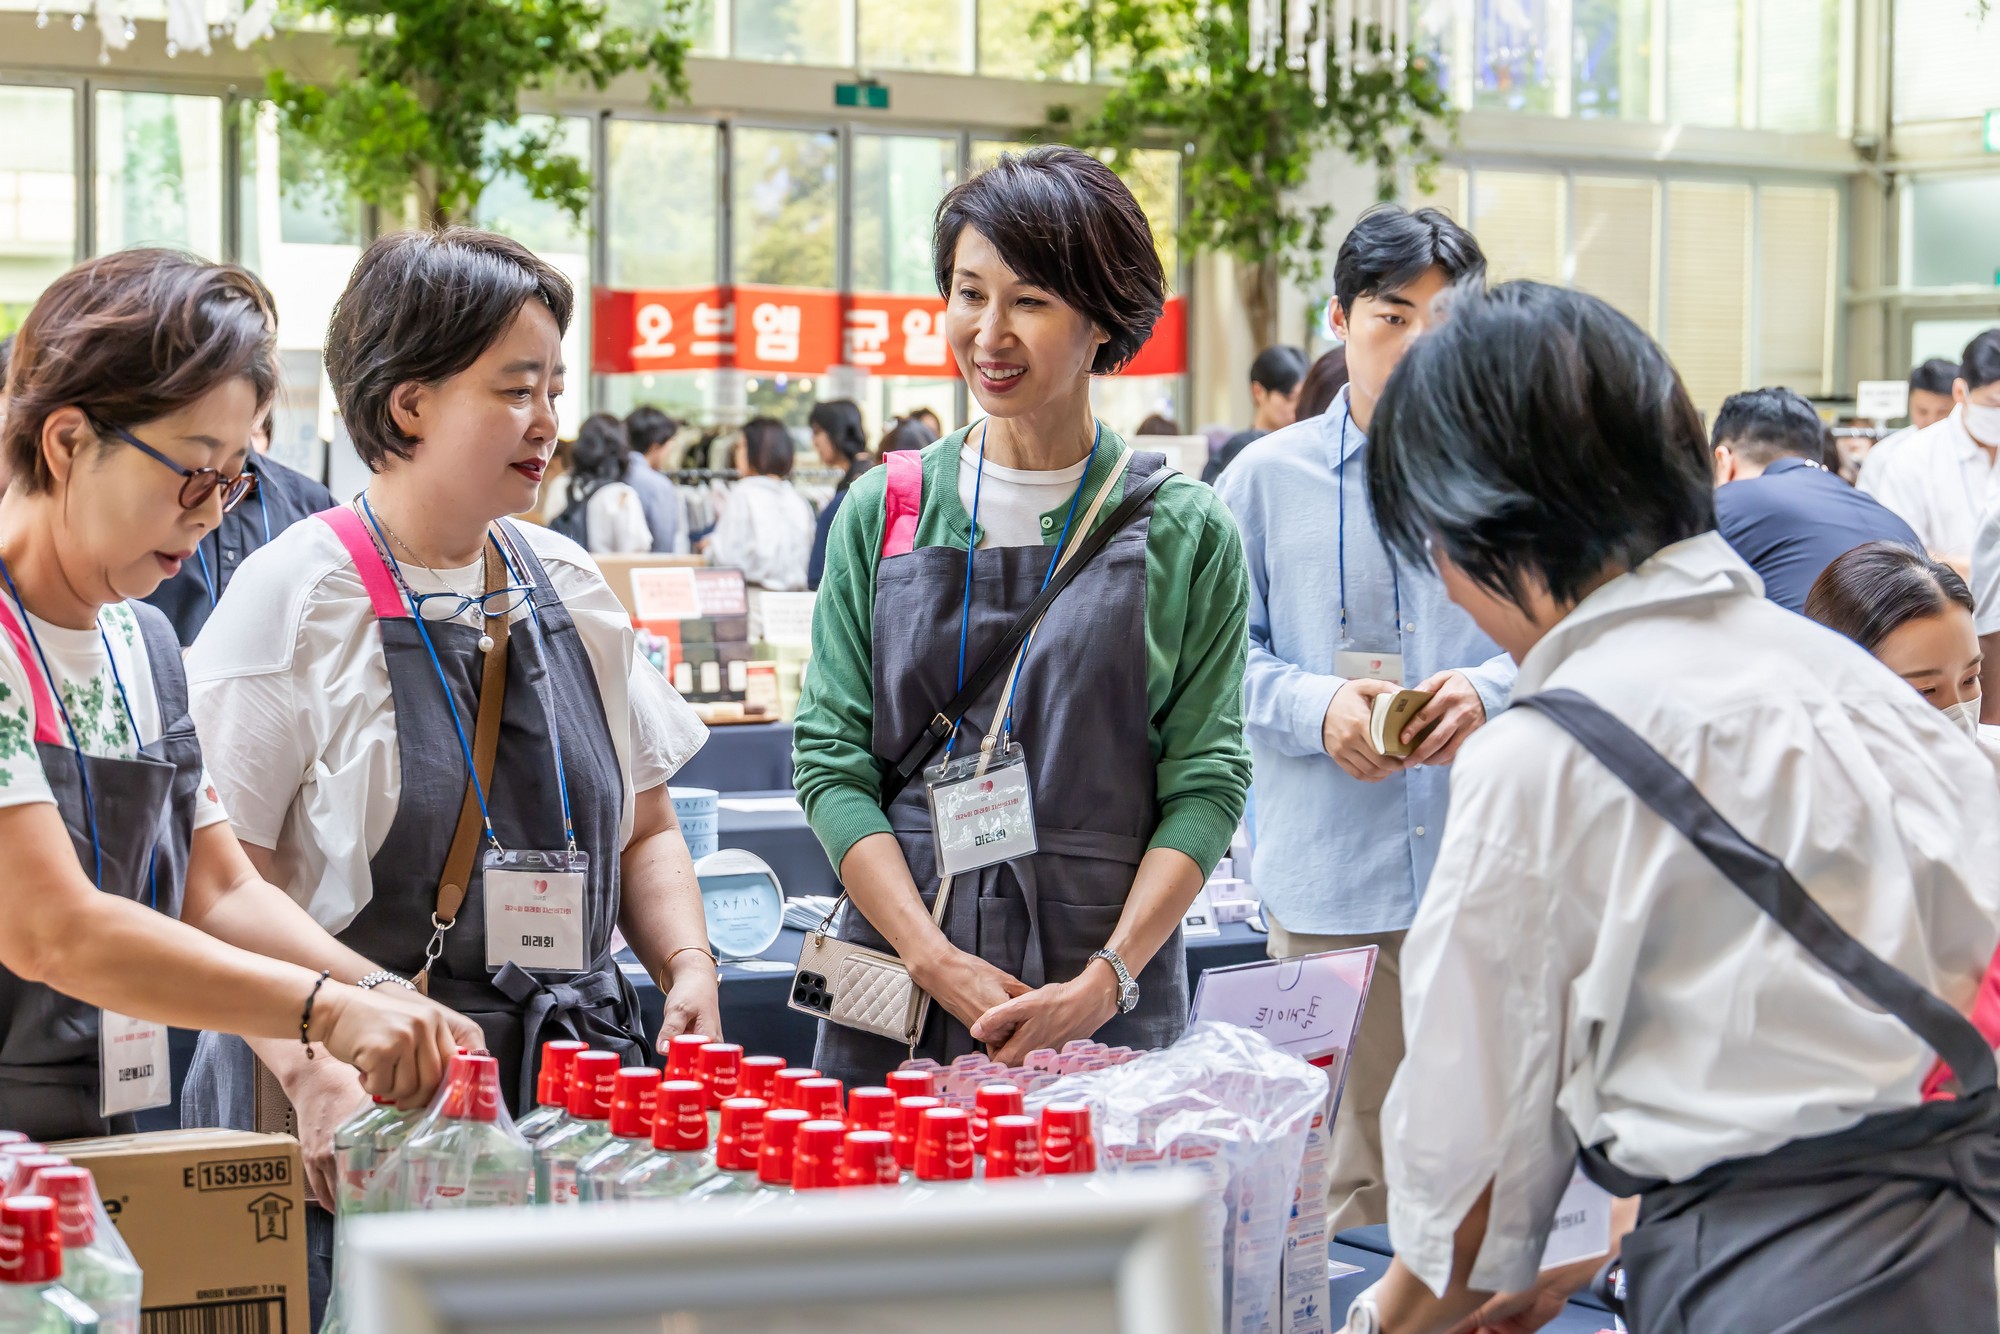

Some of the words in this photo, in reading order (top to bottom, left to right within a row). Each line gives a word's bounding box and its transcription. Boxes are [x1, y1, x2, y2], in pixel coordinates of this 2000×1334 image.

[521, 934, 554, 948] 미래회
[183, 1167, 195, 1188] E
[202, 1161, 287, 1186] 1539336
